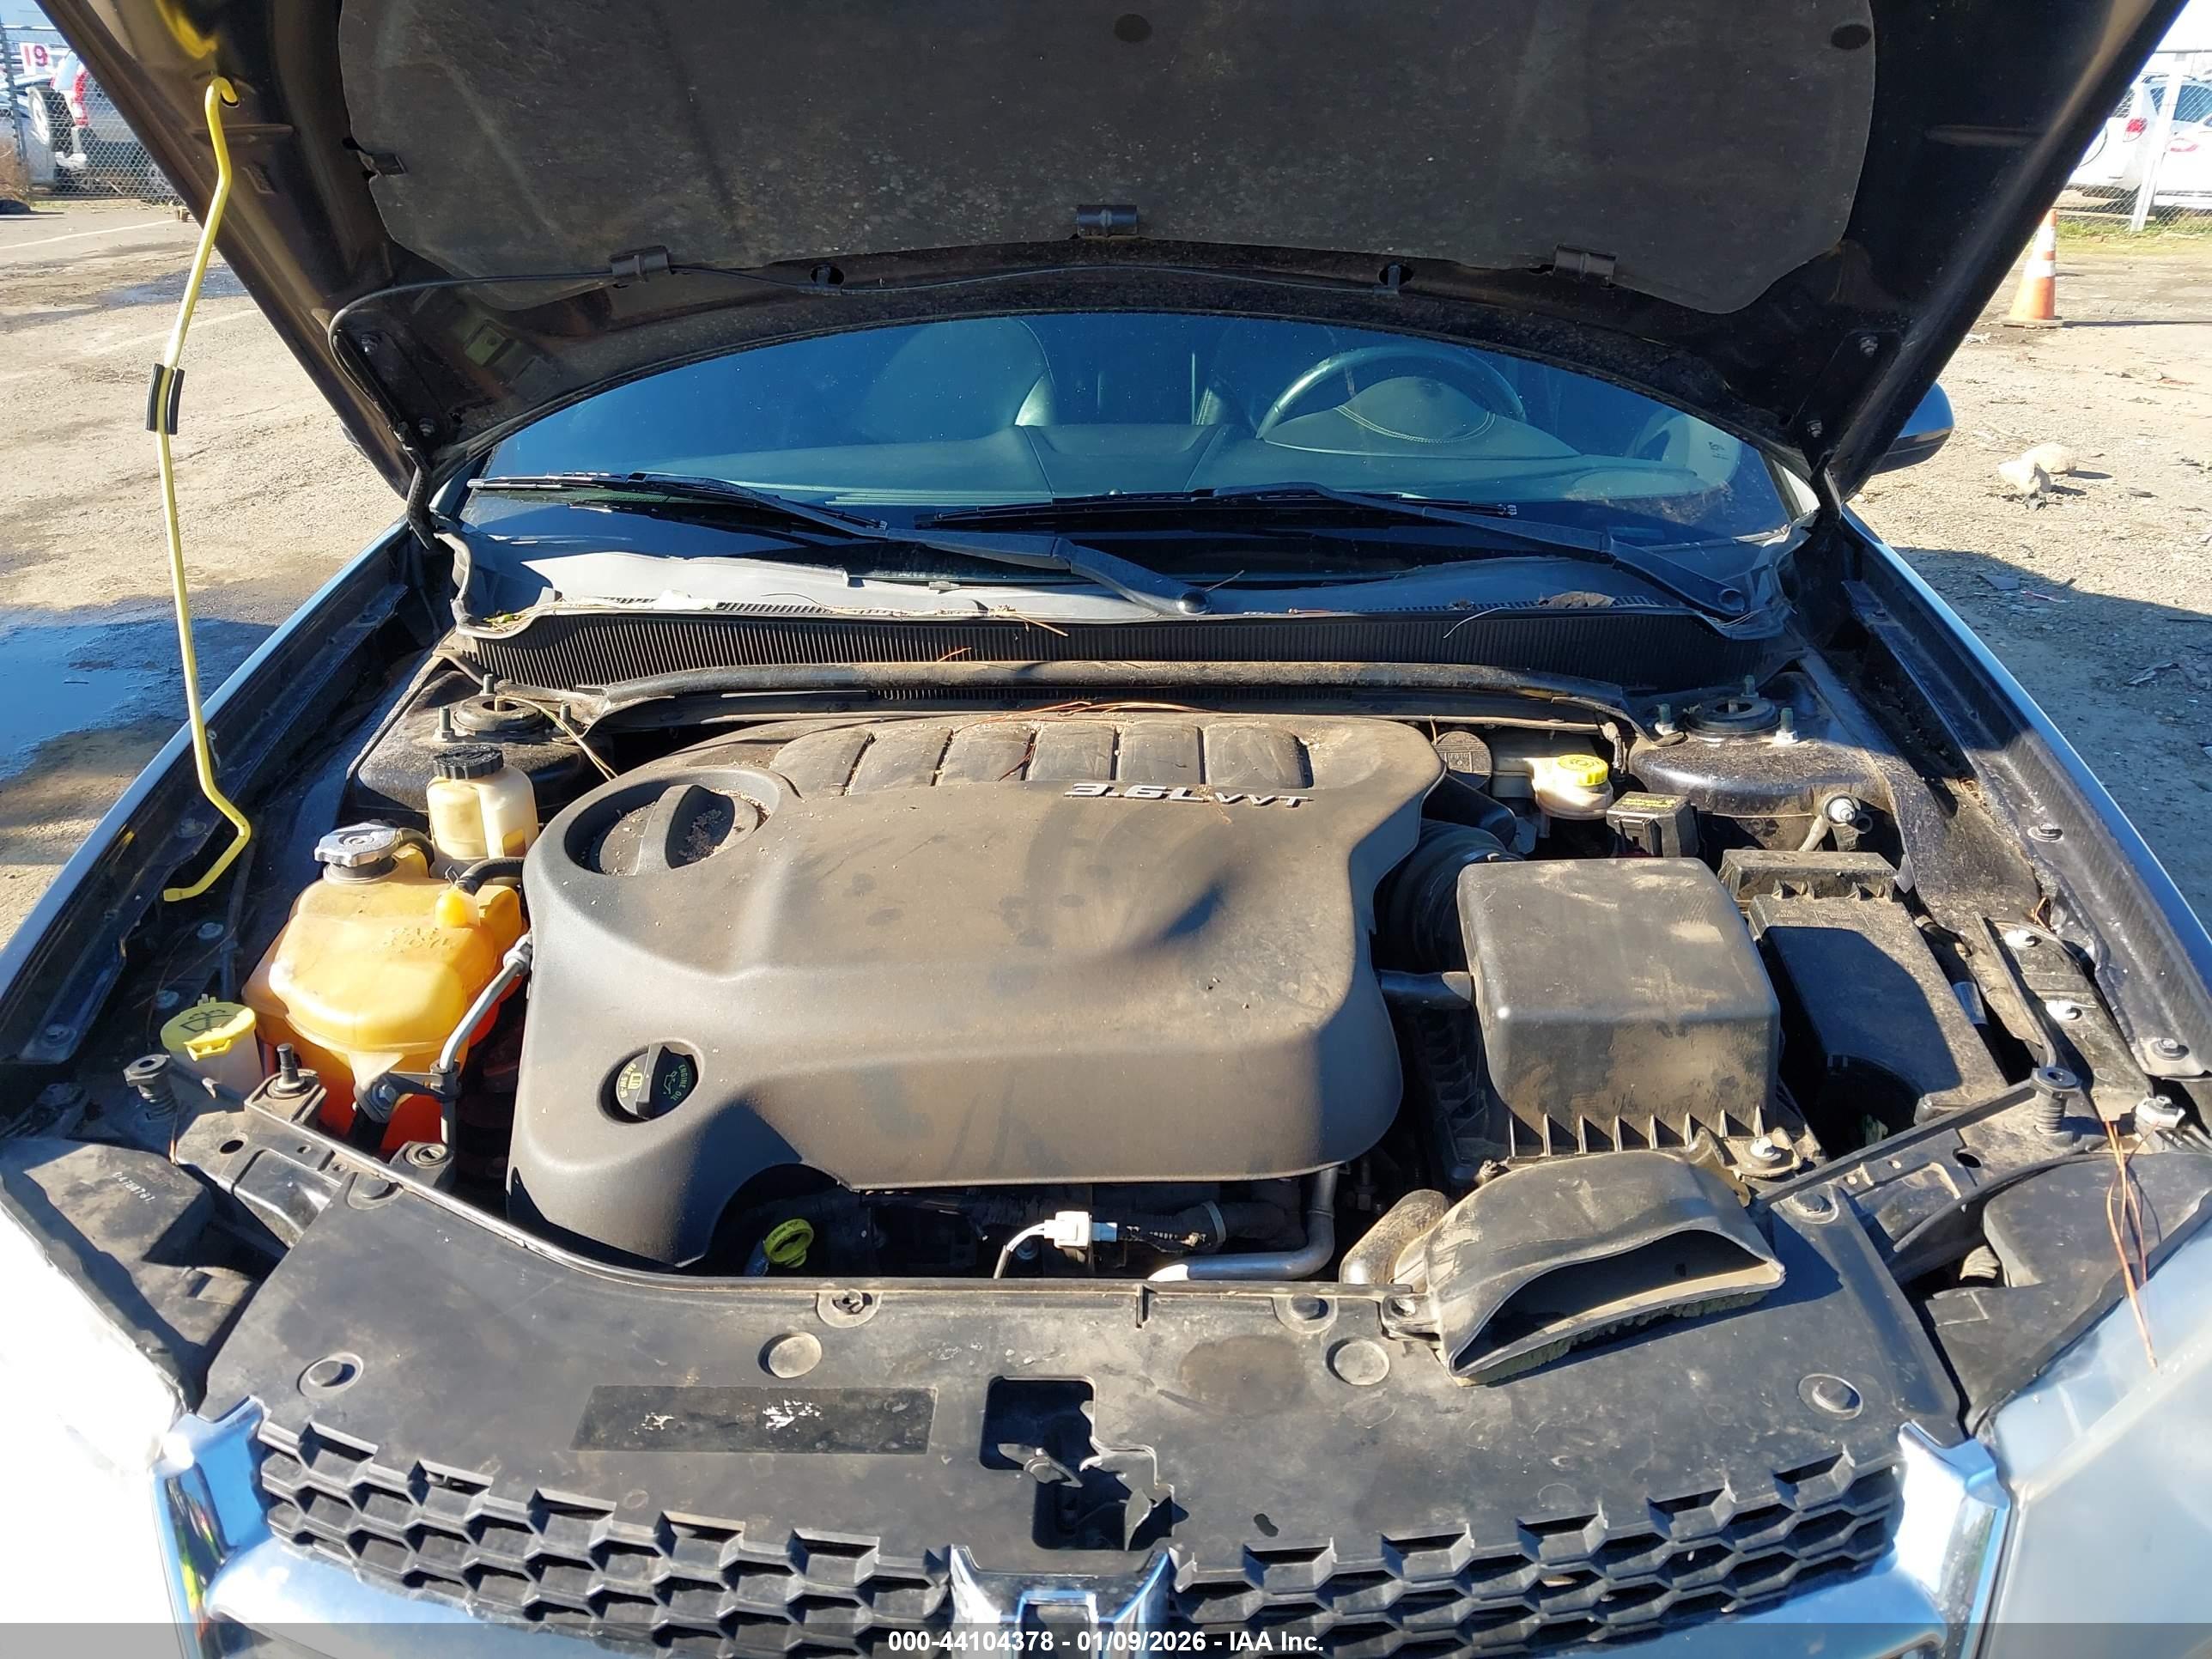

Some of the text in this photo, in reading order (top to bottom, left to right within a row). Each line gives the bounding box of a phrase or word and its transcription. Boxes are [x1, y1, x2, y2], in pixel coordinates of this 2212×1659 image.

[24, 46, 48, 66] 19
[1064, 783, 1310, 807] 3.6L VVT
[671, 1064, 688, 1101] ENGINE OIL
